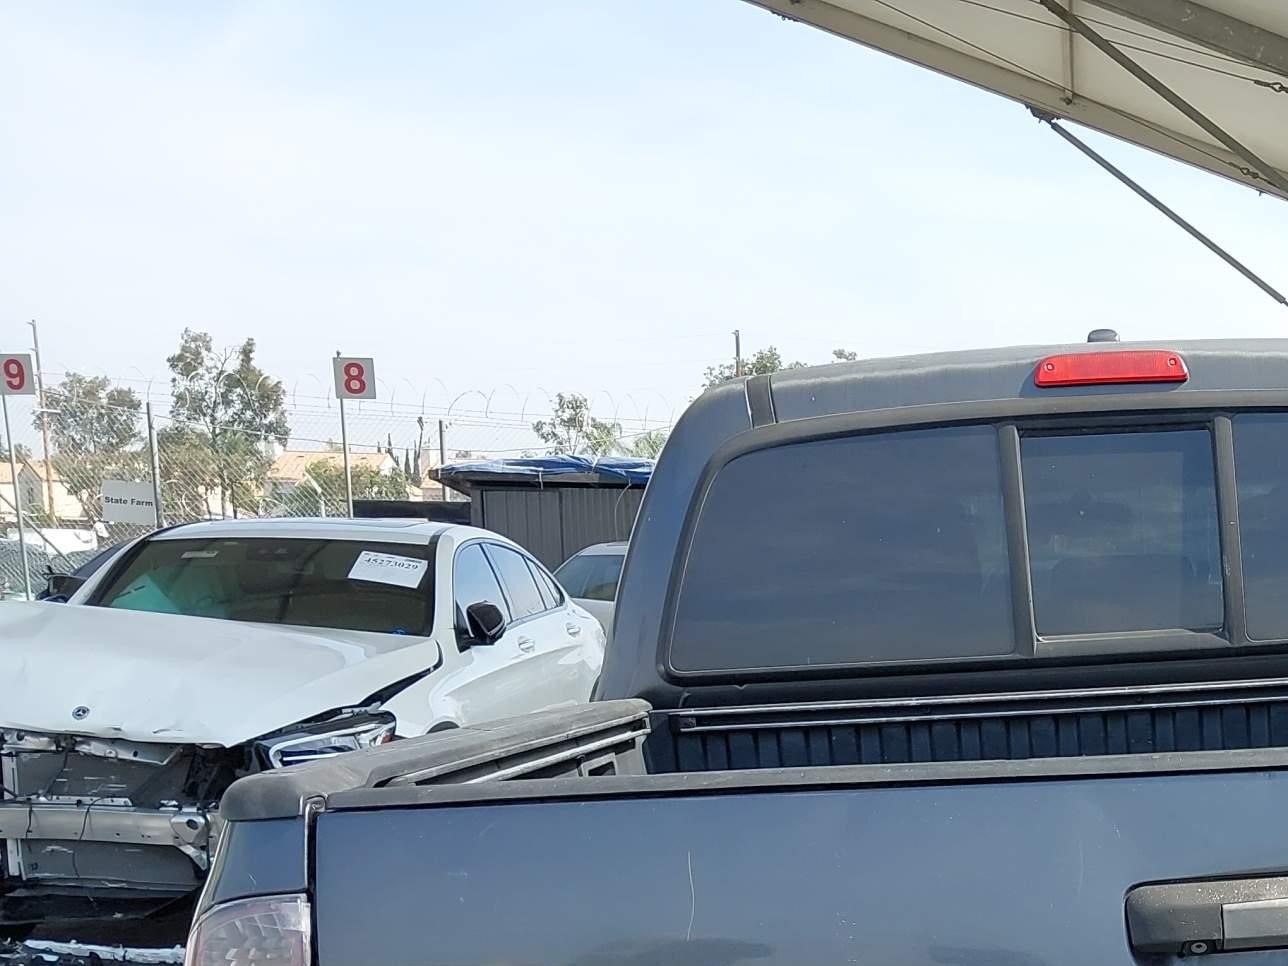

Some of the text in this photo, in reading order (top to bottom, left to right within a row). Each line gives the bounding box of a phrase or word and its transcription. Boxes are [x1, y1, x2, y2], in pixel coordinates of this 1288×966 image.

[4, 359, 25, 390] 9
[344, 362, 366, 395] 8
[104, 496, 153, 507] State Farm
